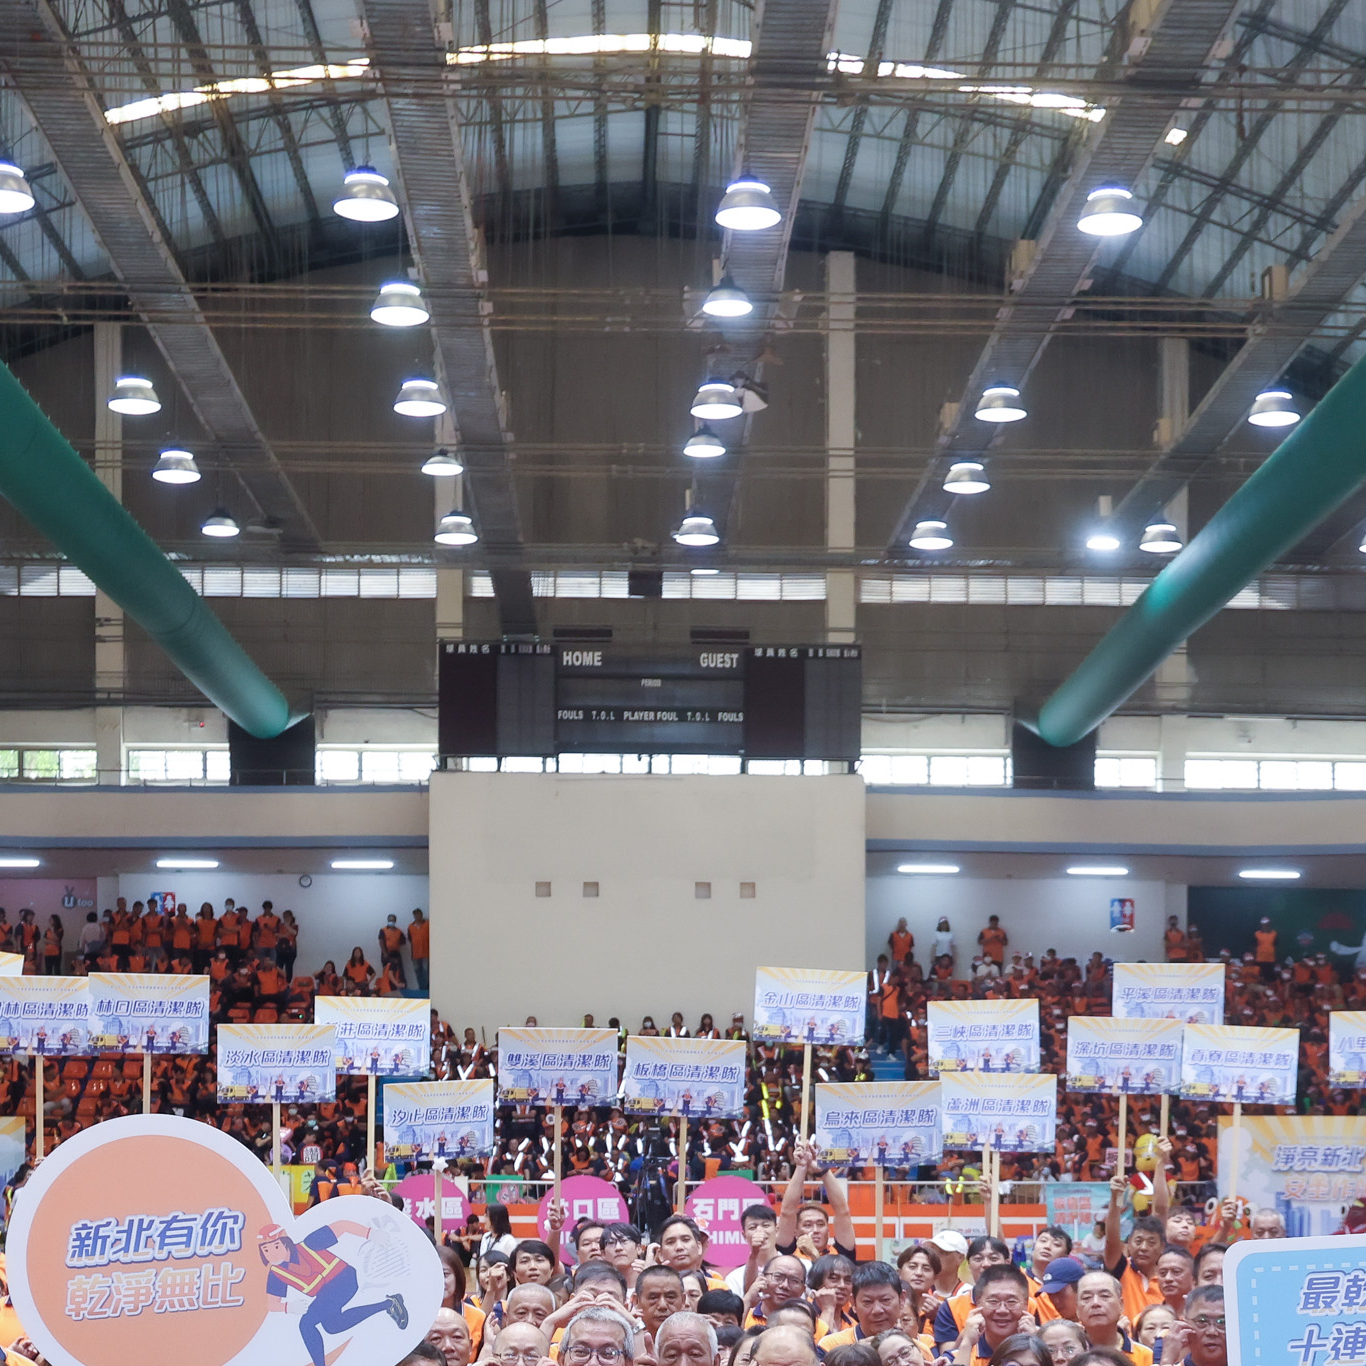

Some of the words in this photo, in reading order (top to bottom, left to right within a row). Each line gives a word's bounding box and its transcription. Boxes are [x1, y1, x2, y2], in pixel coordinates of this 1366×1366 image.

[563, 651, 602, 666] HOME
[700, 653, 739, 668] GUEST
[557, 710, 584, 720] FOULS
[623, 711, 655, 721] PLAYER
[657, 711, 679, 721] FOUL
[718, 712, 744, 722] FOULS
[763, 991, 859, 1010] 金山區清潔隊
[1122, 987, 1218, 1003] 平溪區清潔隊
[96, 999, 203, 1018] 林口區清潔隊
[936, 1024, 1033, 1041] 三峽區清潔隊
[225, 1049, 332, 1067] 淡水區清潔隊
[1075, 1041, 1176, 1059] 深坑區清潔隊
[1190, 1049, 1293, 1068] 貢寮區清潔隊
[507, 1053, 613, 1070] 雙溪區清潔隊
[634, 1062, 740, 1082] 板橋區清潔隊
[391, 1104, 489, 1126] 汐止區清潔隊
[947, 1097, 1049, 1116] 蘆洲區清潔隊
[824, 1108, 937, 1128] 烏來區清潔隊
[66, 1208, 244, 1267] 新北有你
[65, 1263, 245, 1320] 乾淨無比
